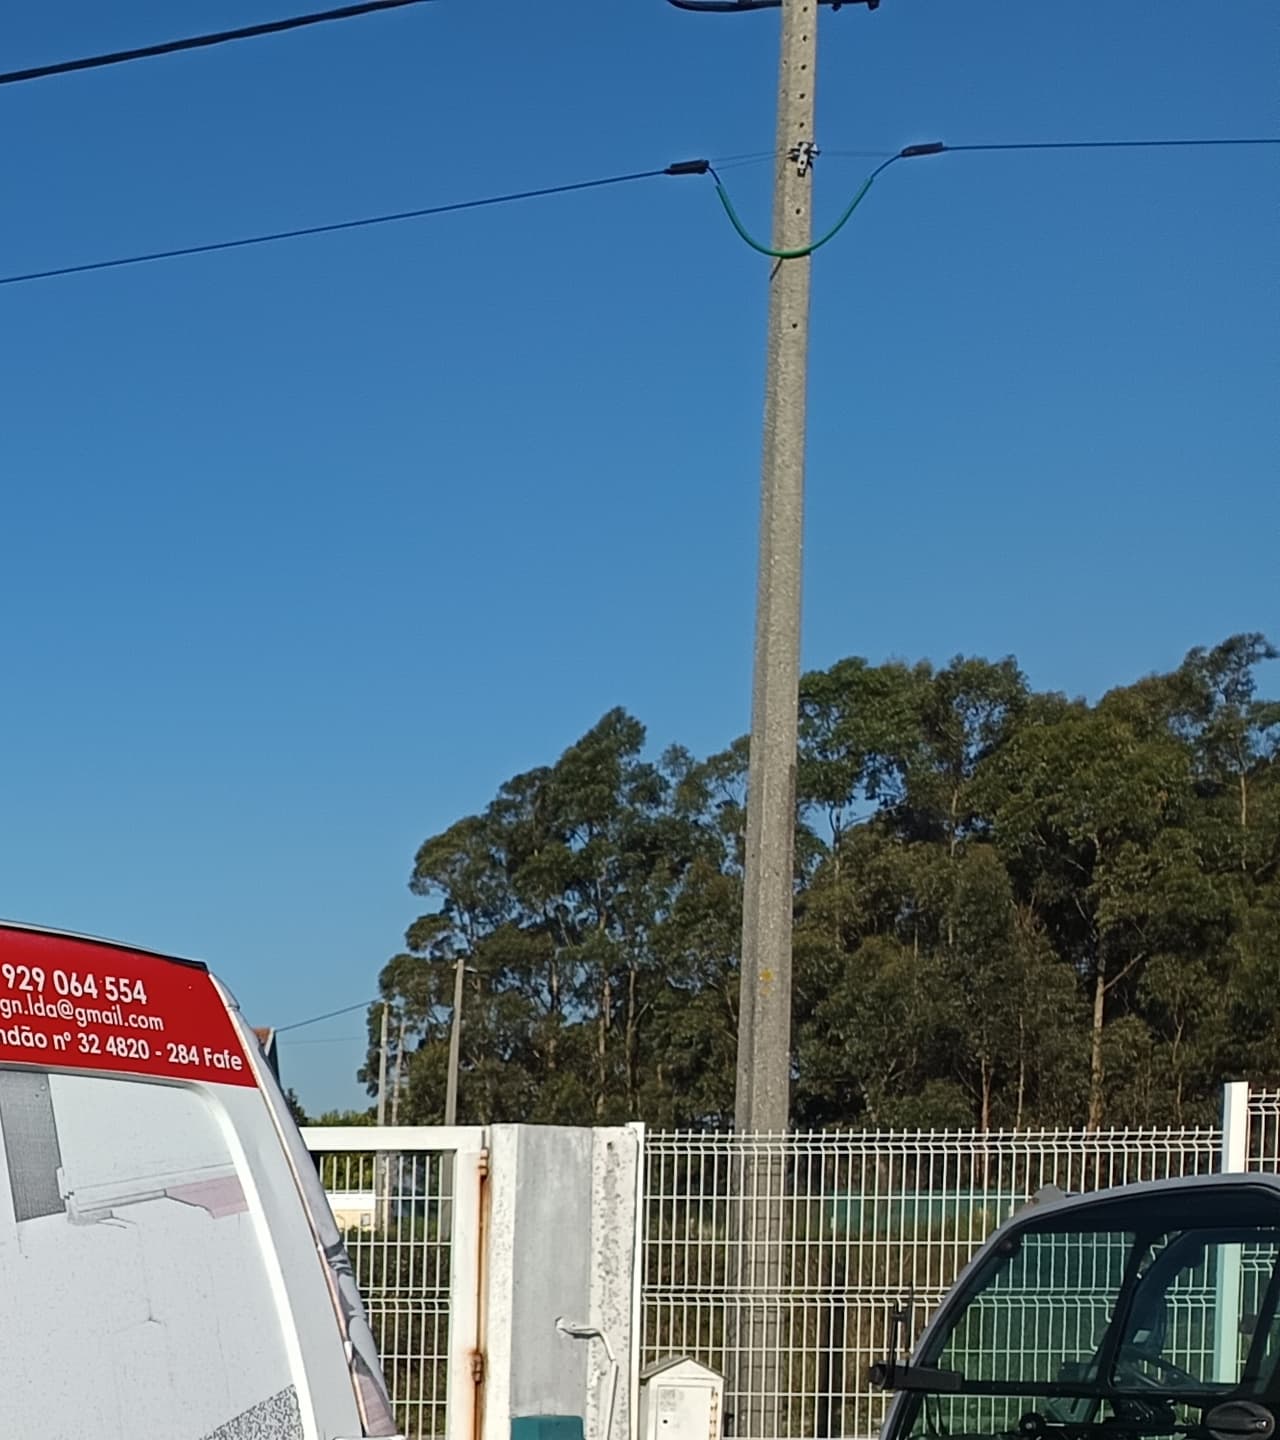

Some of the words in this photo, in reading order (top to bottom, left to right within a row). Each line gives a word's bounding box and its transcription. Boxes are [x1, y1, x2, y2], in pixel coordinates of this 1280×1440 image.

[1, 964, 45, 992] 929
[53, 969, 98, 999] 064
[104, 975, 147, 1005] 554
[78, 1033, 101, 1055] 32
[106, 1036, 150, 1060] 4820
[167, 1043, 199, 1066] 284
[204, 1046, 242, 1071] Fafe
